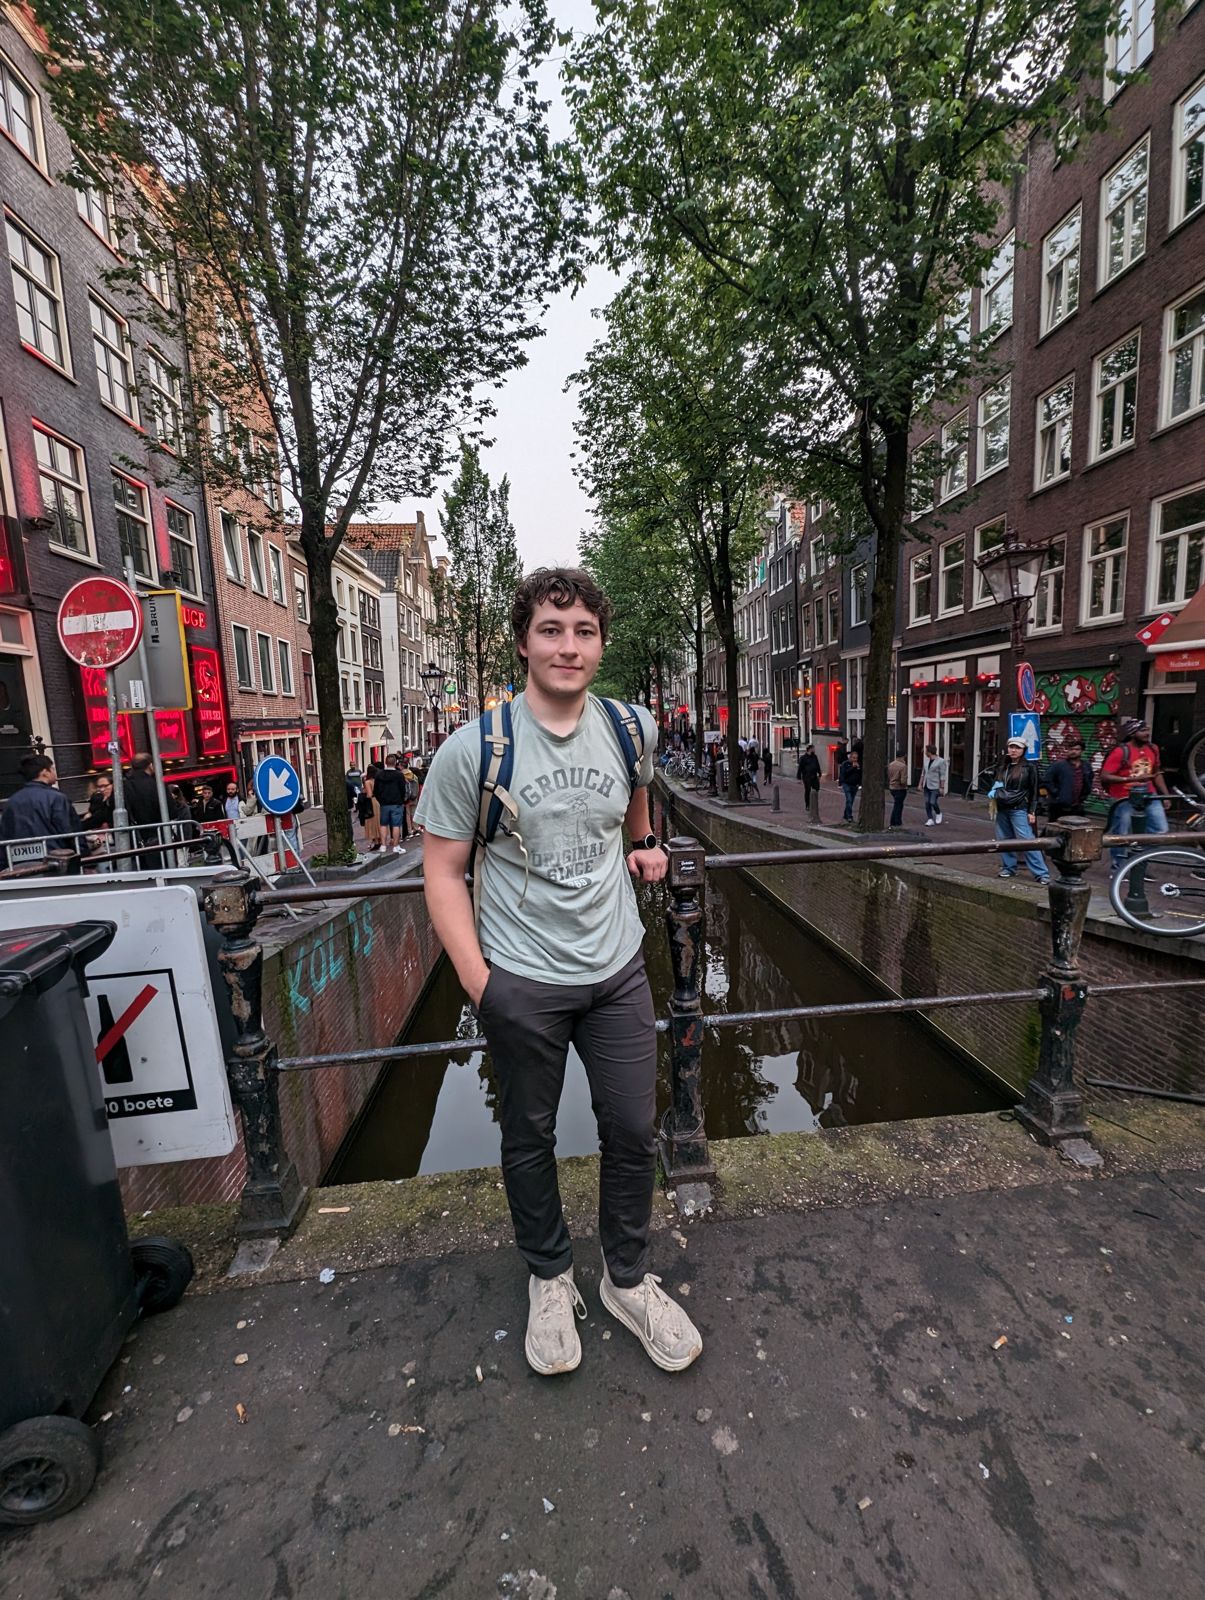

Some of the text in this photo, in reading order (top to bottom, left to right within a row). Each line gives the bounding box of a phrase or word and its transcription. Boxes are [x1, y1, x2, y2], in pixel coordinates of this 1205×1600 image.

[181, 606, 207, 628] UGE
[519, 767, 616, 809] GROUCH
[530, 841, 607, 868] ORIGINAL
[547, 859, 594, 882] SINCE
[123, 1096, 174, 1112] boete
